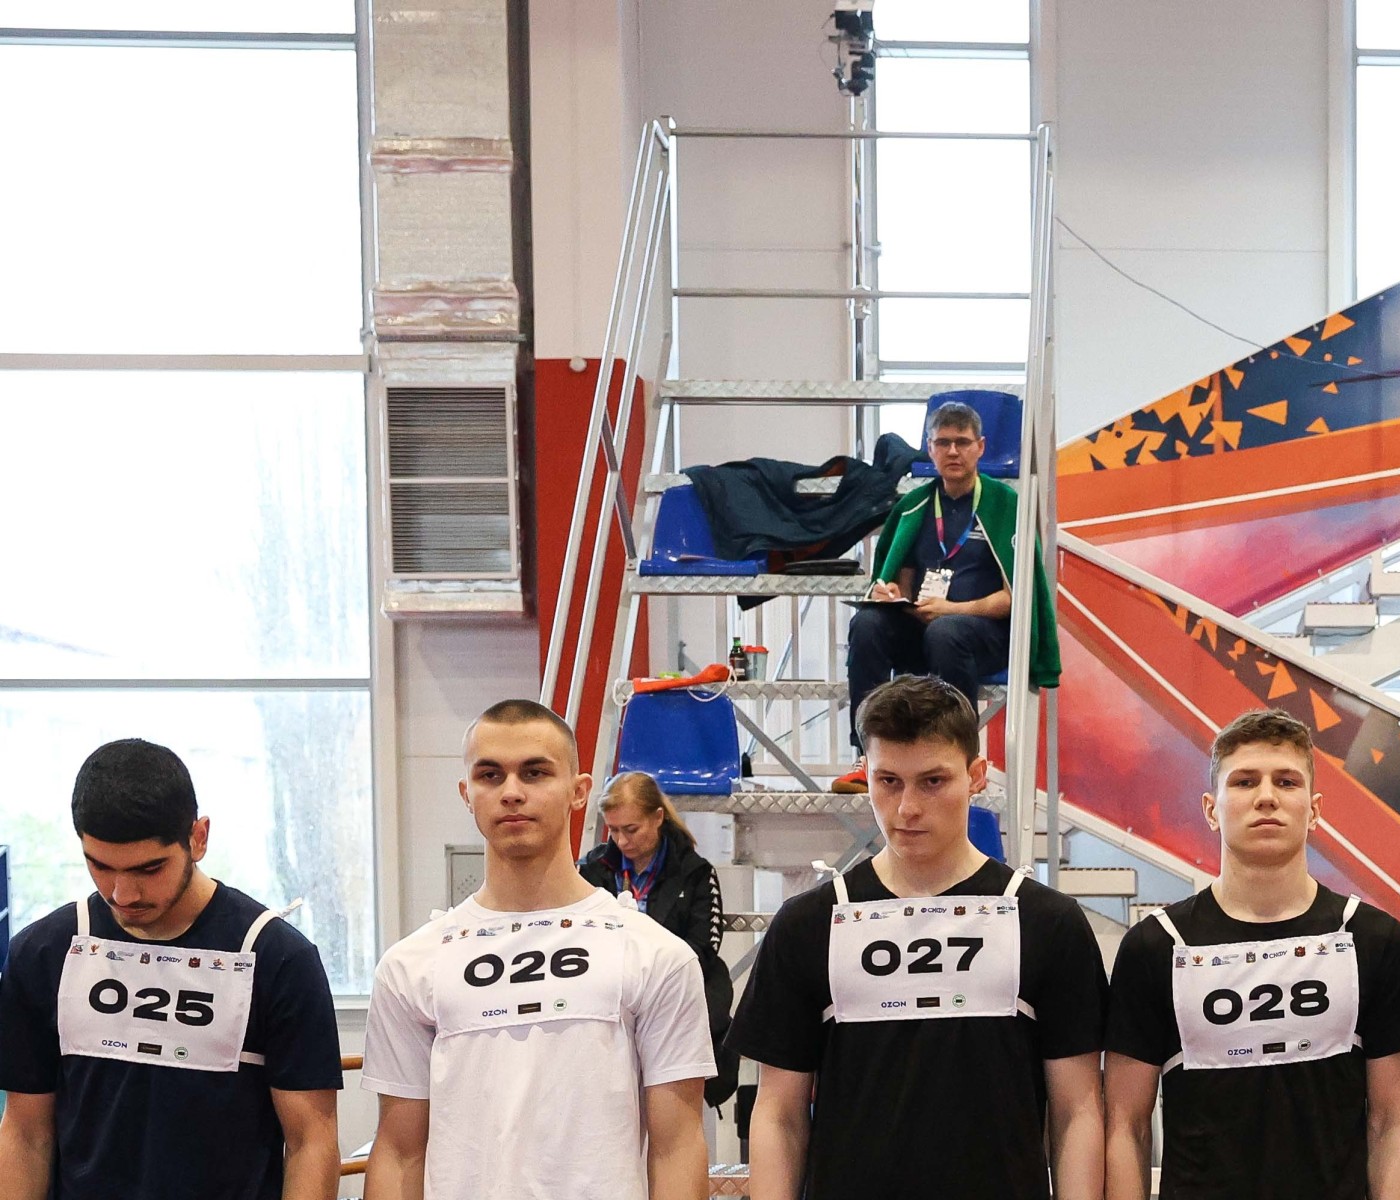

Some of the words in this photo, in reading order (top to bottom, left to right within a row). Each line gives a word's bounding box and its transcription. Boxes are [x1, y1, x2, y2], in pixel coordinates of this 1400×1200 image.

[464, 948, 589, 987] 026
[862, 937, 983, 976] 027
[89, 979, 213, 1026] 025
[482, 1008, 508, 1018] OZON
[881, 1000, 907, 1008] OZON
[1203, 980, 1329, 1025] 028
[101, 1038, 128, 1049] OZON
[1227, 1048, 1253, 1056] OZON
